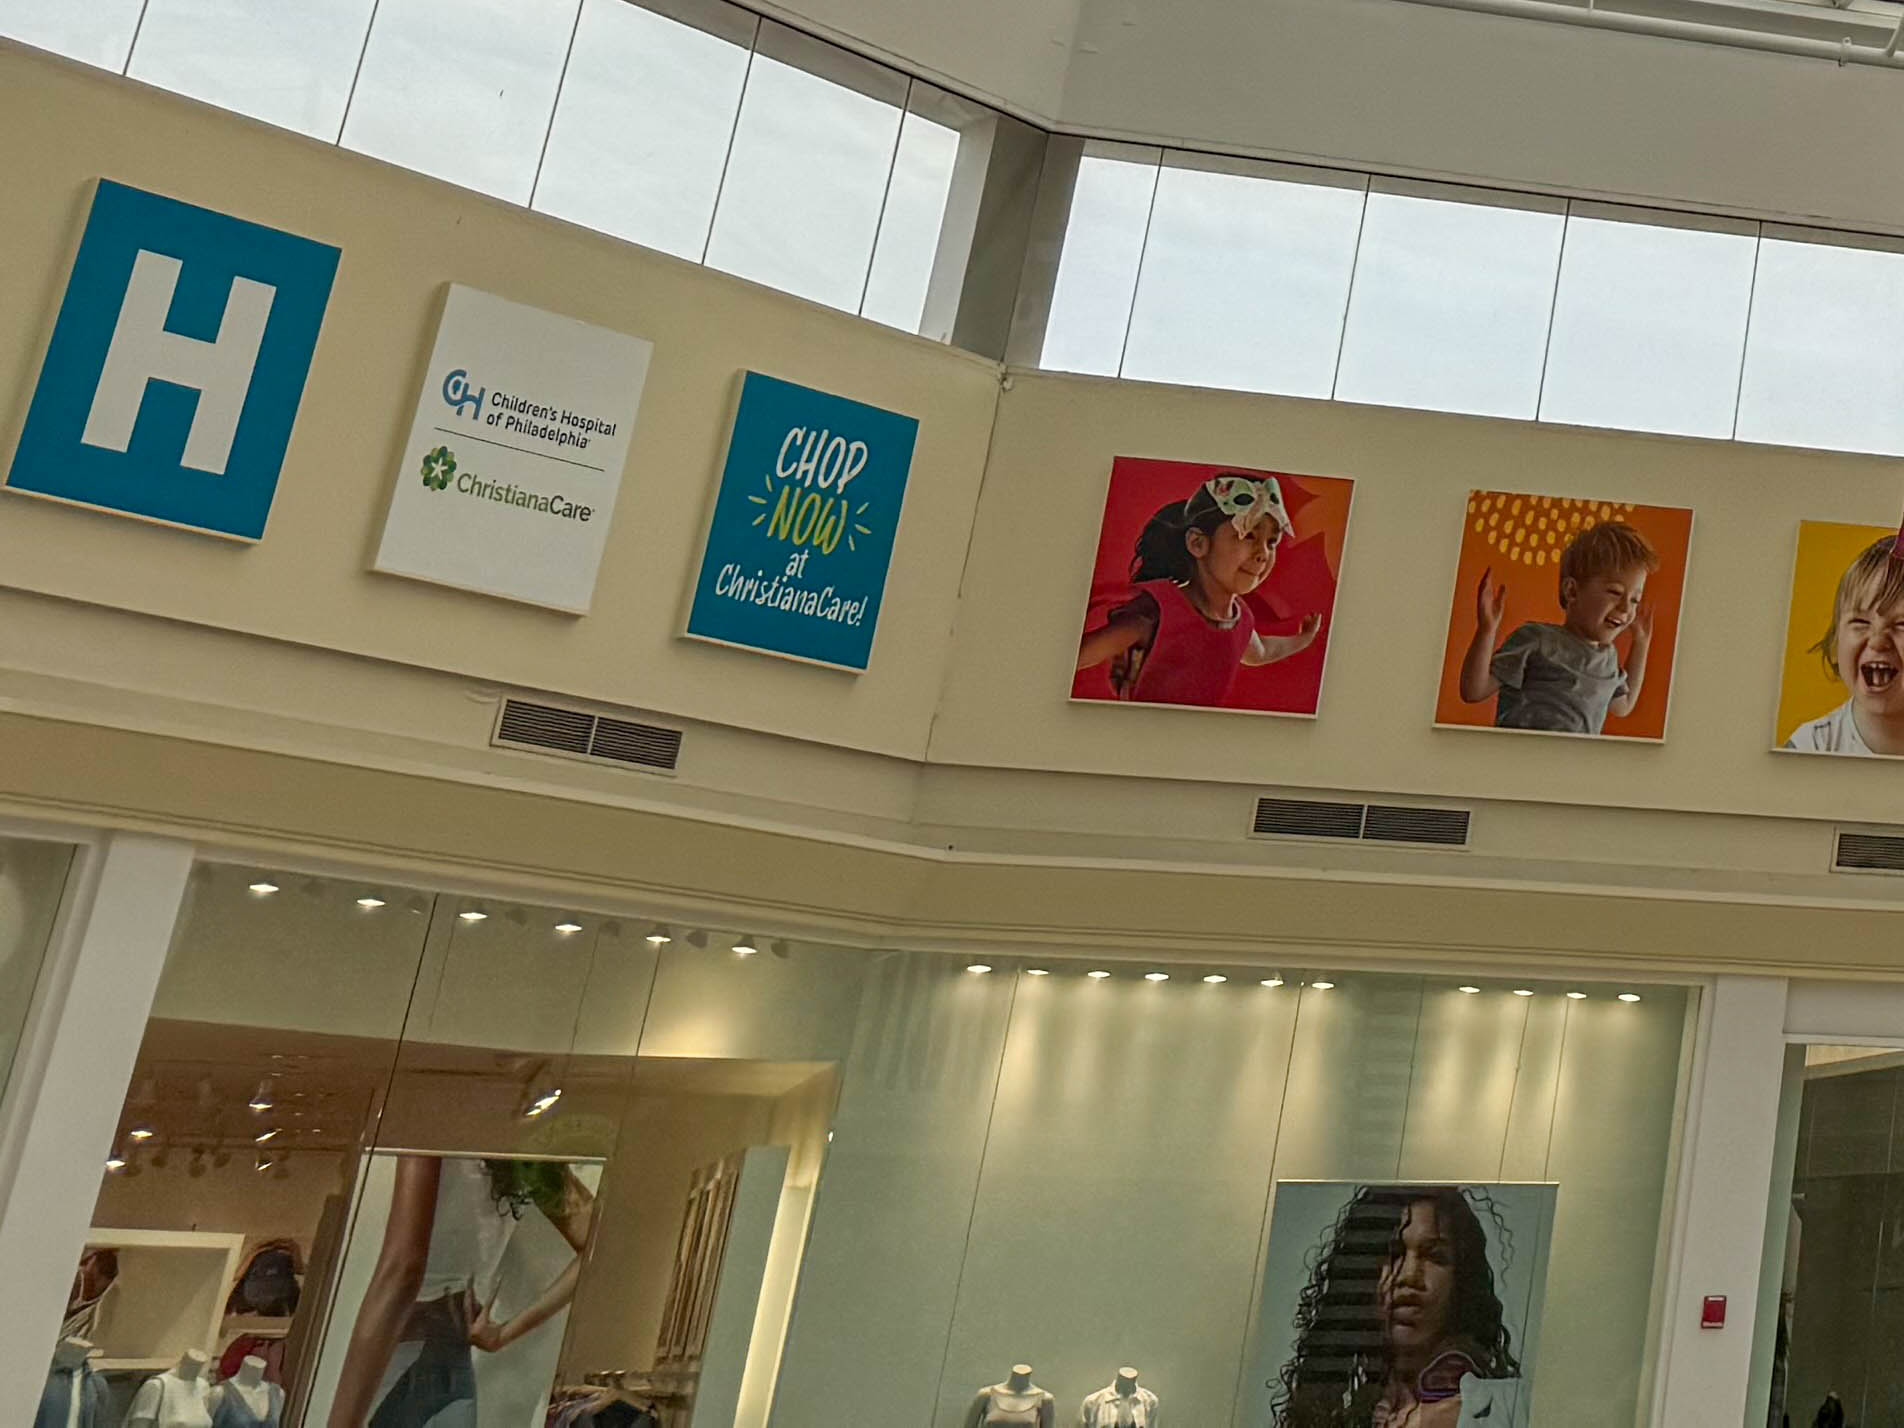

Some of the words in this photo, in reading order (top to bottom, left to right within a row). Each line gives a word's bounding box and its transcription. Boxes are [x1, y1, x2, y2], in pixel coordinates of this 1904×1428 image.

[80, 248, 277, 476] H
[486, 412, 503, 425] of
[505, 415, 589, 449] Philadelphia
[491, 392, 558, 422] Children's
[560, 410, 617, 437] Hospital
[776, 426, 868, 495] CHOP
[457, 472, 592, 522] ChristianaCare
[767, 485, 849, 555] NOW
[785, 549, 809, 578] at
[715, 563, 869, 627] ChristianaCare!
